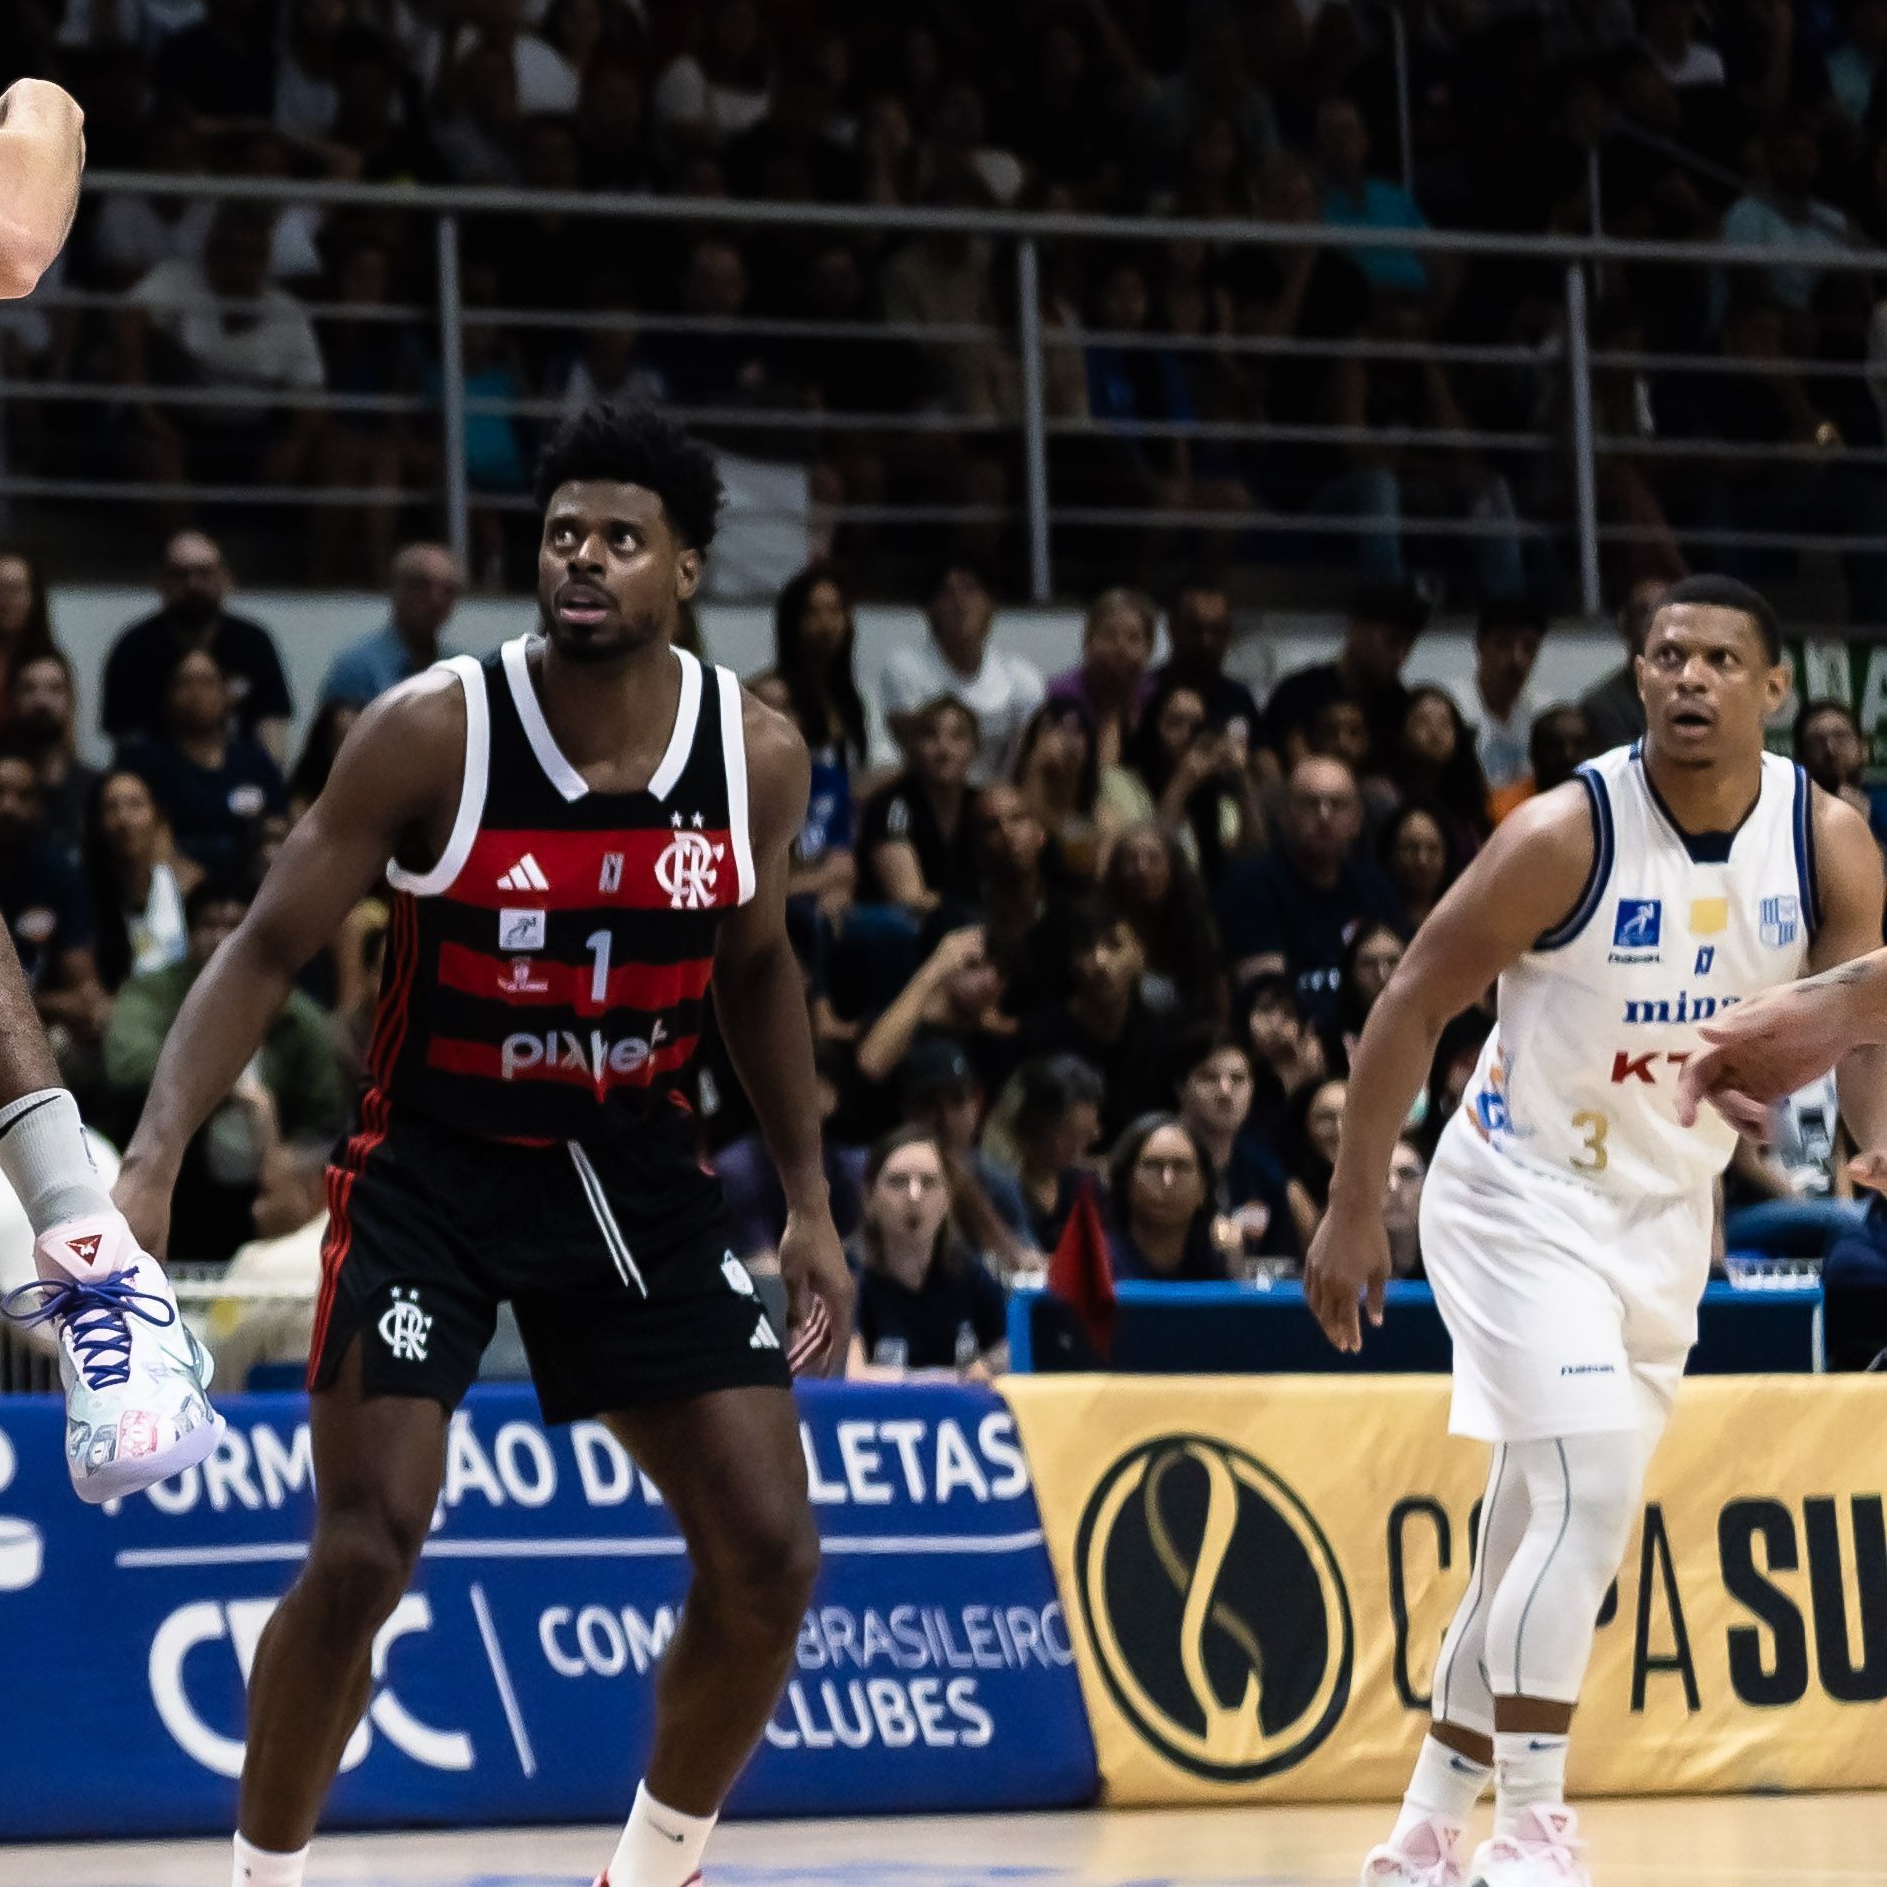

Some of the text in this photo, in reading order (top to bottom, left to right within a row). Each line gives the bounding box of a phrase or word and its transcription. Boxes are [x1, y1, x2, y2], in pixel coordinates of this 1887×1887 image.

[586, 929, 612, 1002] 1
[1570, 1109, 1610, 1173] 3
[799, 1414, 1030, 1504] LETAS
[764, 1677, 994, 1749] CLUBES
